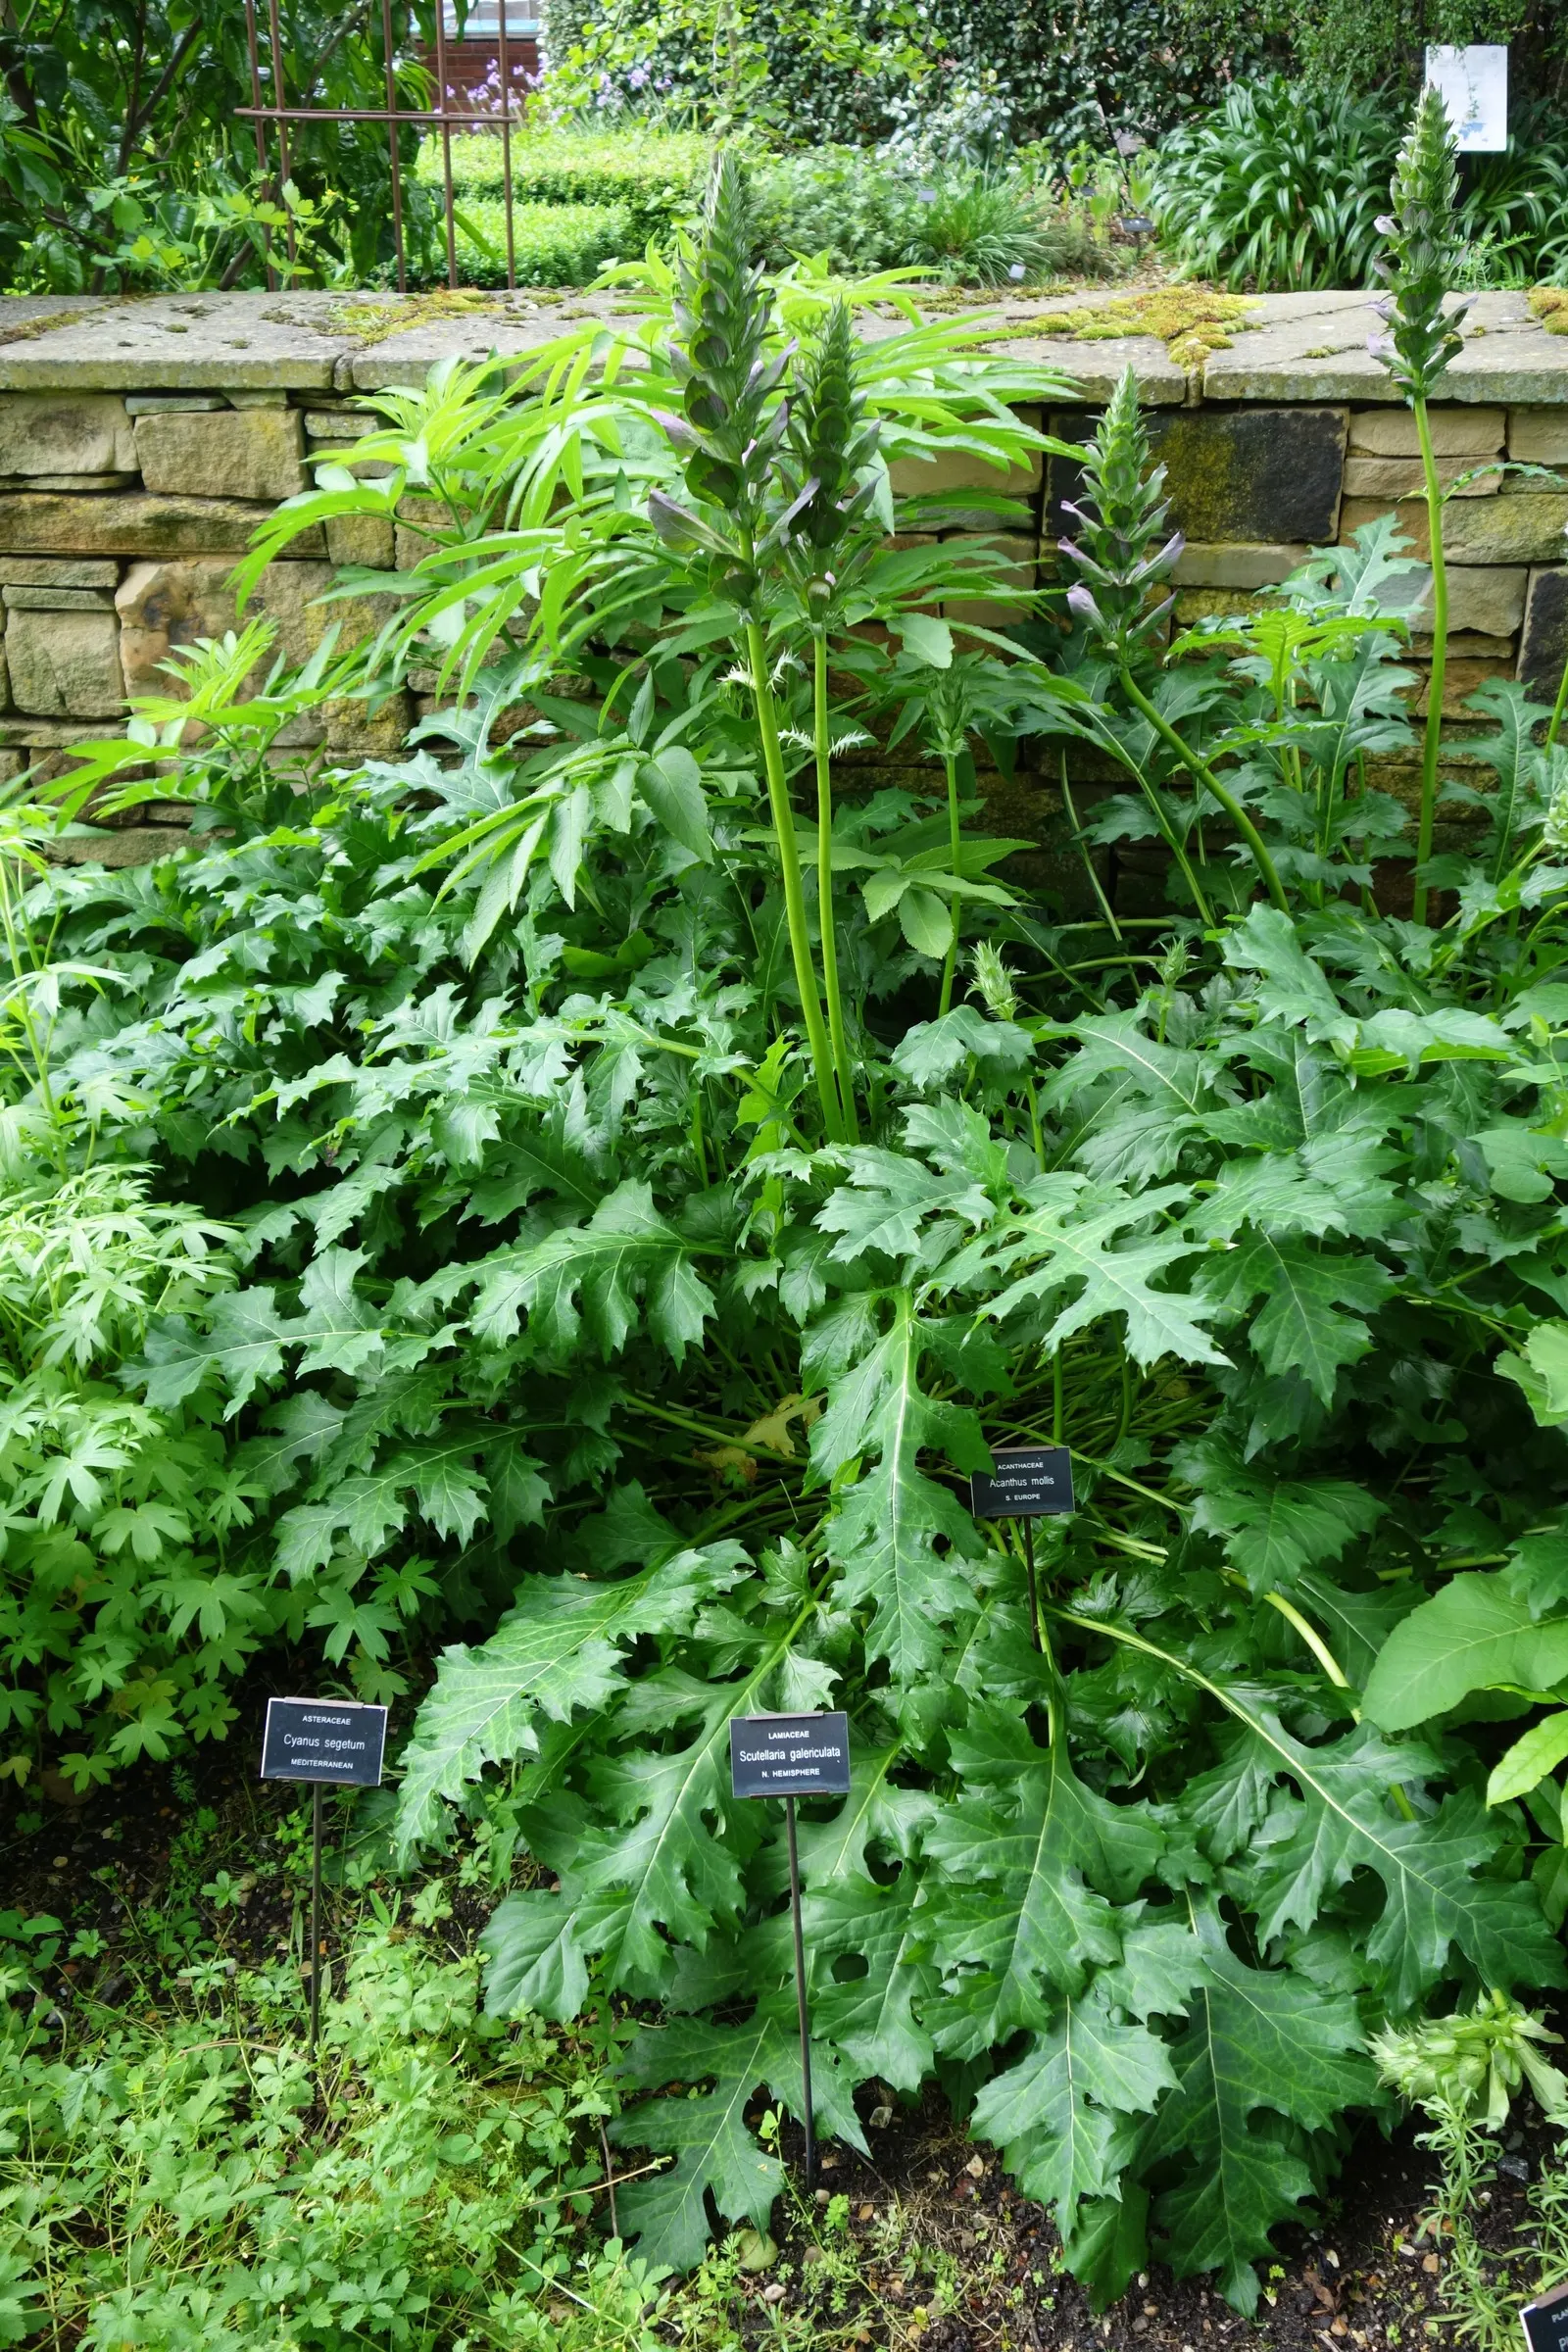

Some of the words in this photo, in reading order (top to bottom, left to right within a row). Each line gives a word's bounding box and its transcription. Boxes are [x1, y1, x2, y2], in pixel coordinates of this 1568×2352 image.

[990, 1478, 1027, 1488] Acanthus
[1031, 1476, 1054, 1486] mollis
[302, 1715, 351, 1725] ASTERACEAE
[768, 1731, 809, 1740] LAMIACEAE
[283, 1734, 319, 1747] Cyanus
[324, 1739, 366, 1750] segetum
[740, 1749, 785, 1761] Scutellaria
[790, 1746, 841, 1761] galericulata
[291, 1758, 353, 1769] MEDITERRANEAN
[772, 1768, 820, 1777] HEMISPHERE
